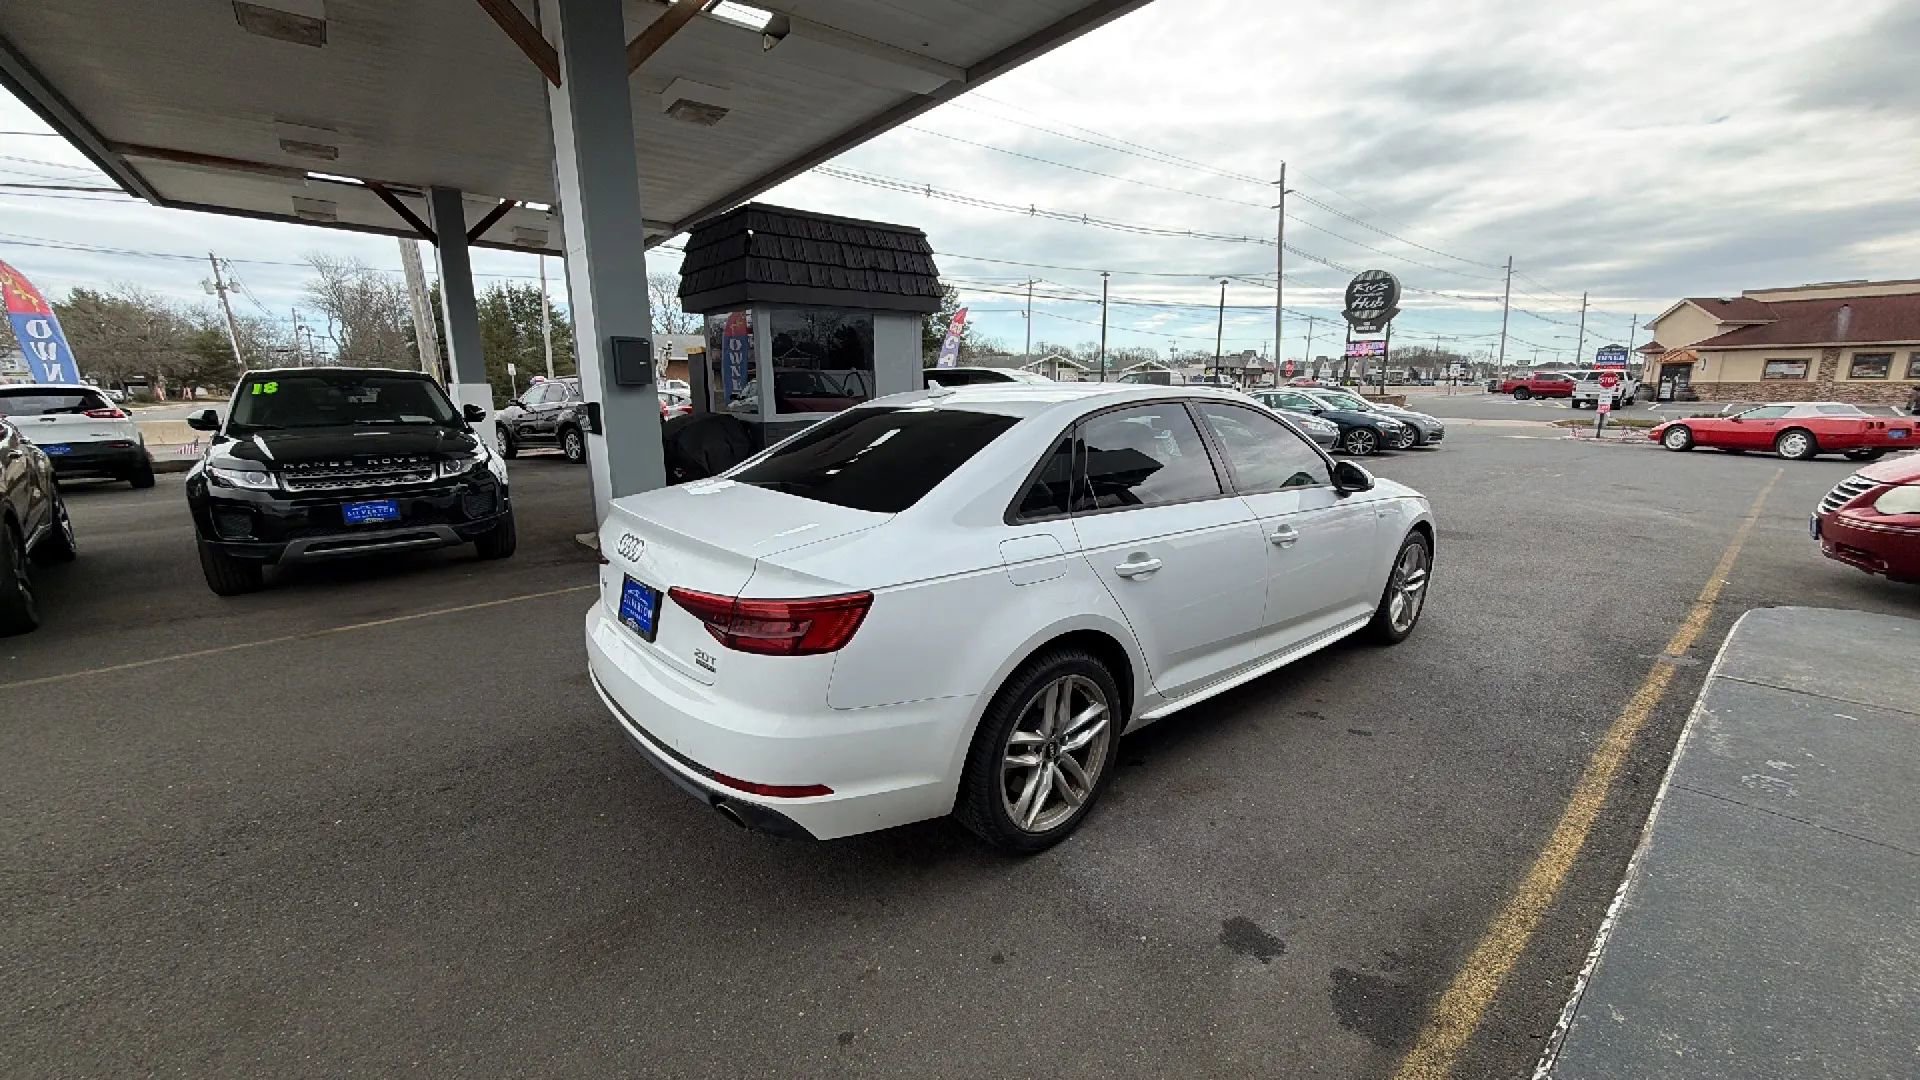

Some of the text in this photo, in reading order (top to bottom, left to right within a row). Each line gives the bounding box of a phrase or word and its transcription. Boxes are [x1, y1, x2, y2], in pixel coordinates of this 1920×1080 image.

[1351, 296, 1384, 309] Hub
[1600, 376, 1618, 384] STOP
[251, 381, 279, 395] 18
[283, 456, 430, 470] RANGE ROVER
